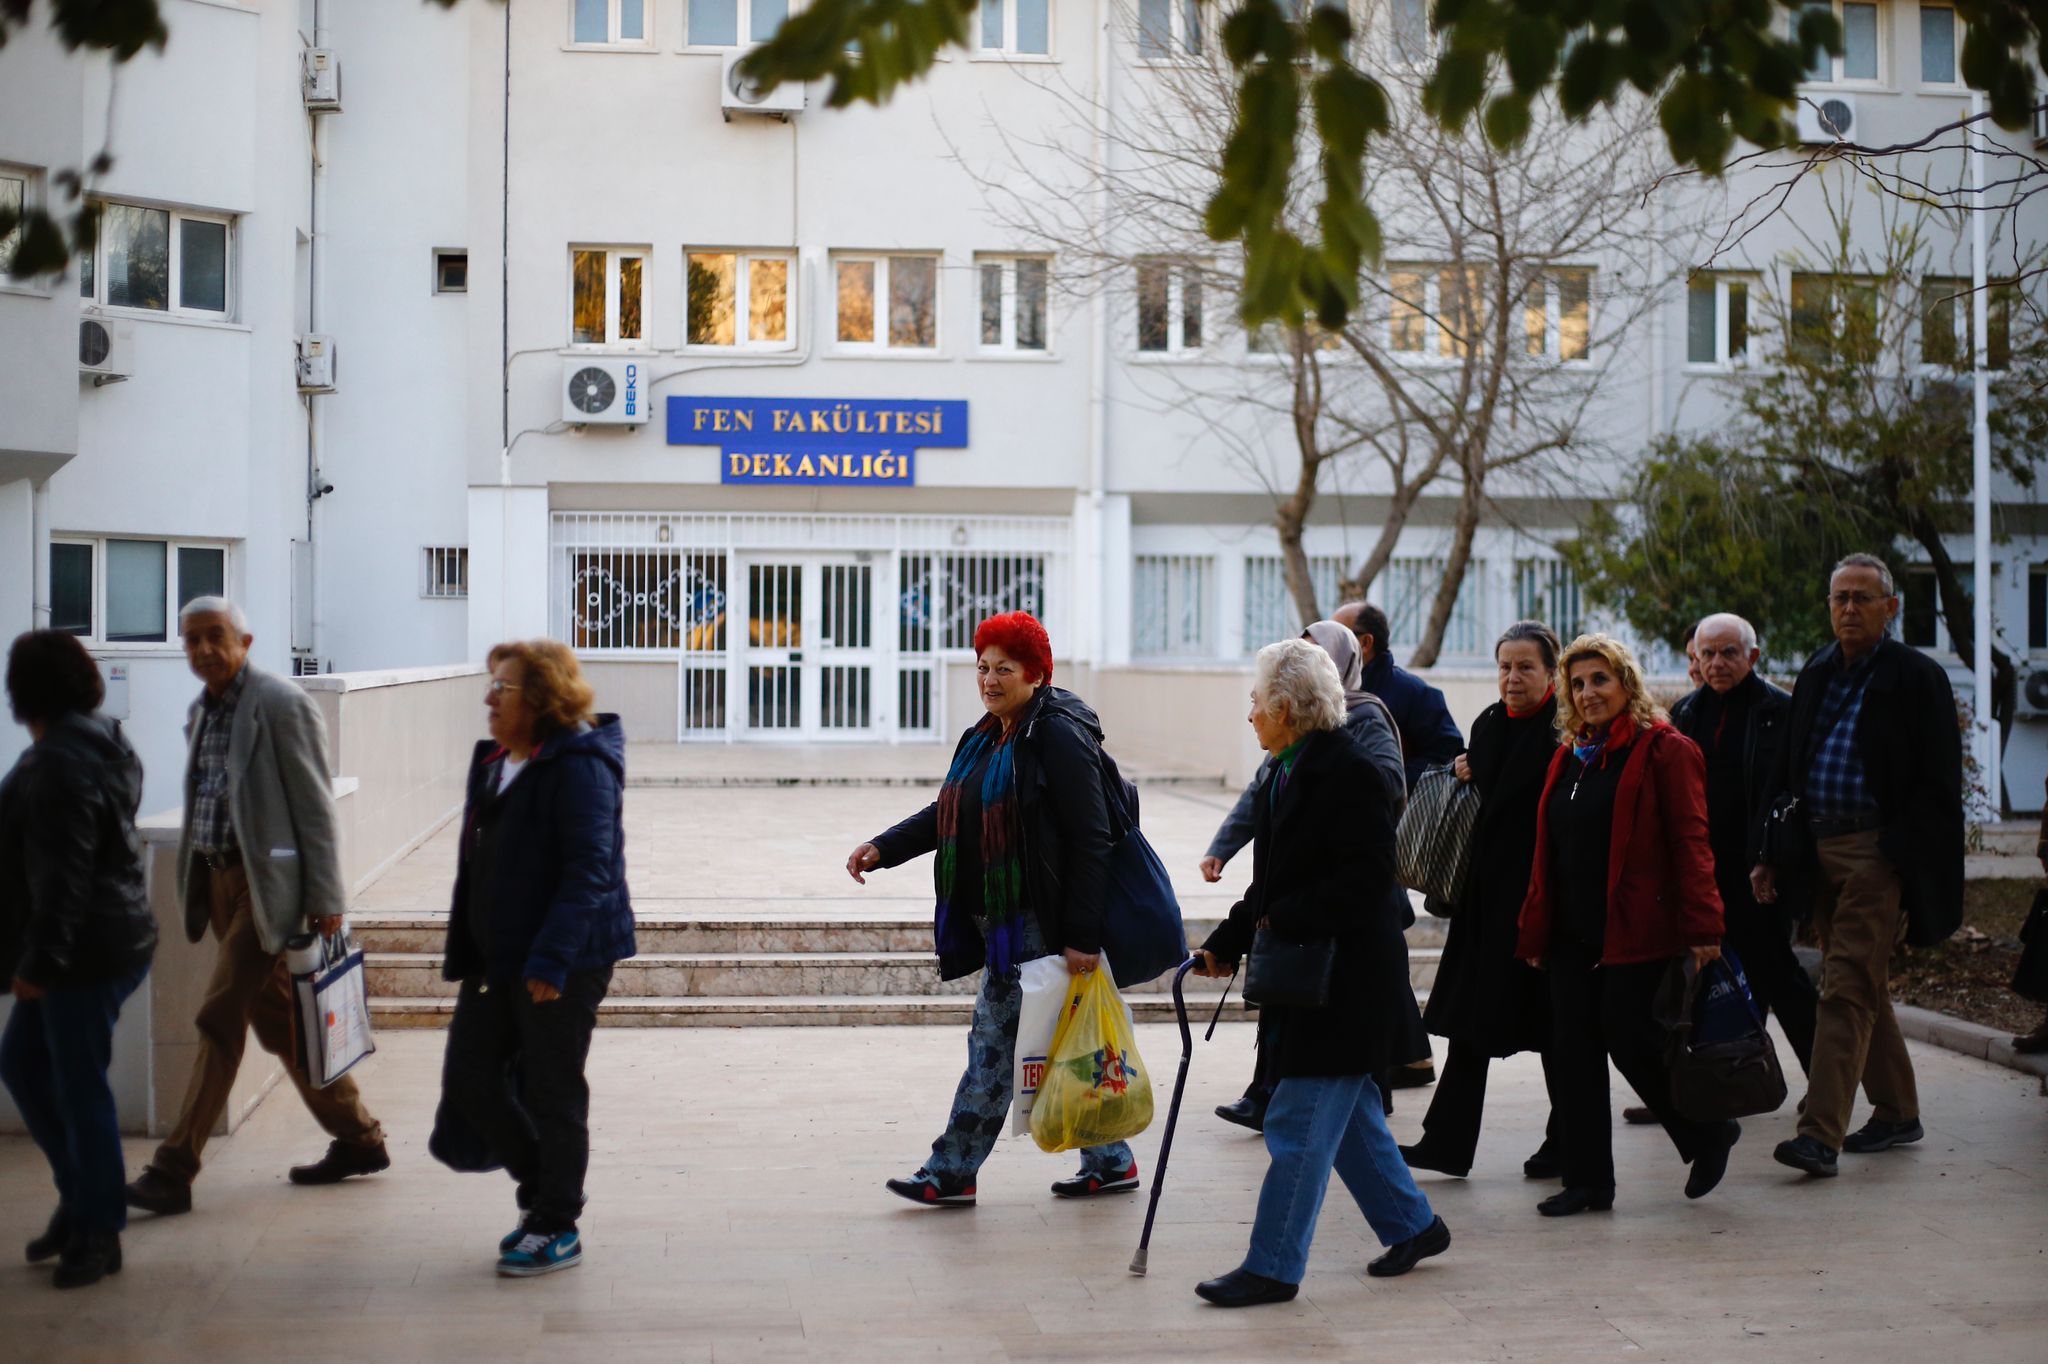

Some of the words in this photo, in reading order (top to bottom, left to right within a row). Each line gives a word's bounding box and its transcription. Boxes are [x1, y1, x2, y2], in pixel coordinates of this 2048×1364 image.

[625, 364, 637, 416] BEKO
[692, 408, 754, 432] FEN
[772, 403, 944, 434] FAKÜLTESİ
[728, 449, 909, 479] DEKANLIĞI
